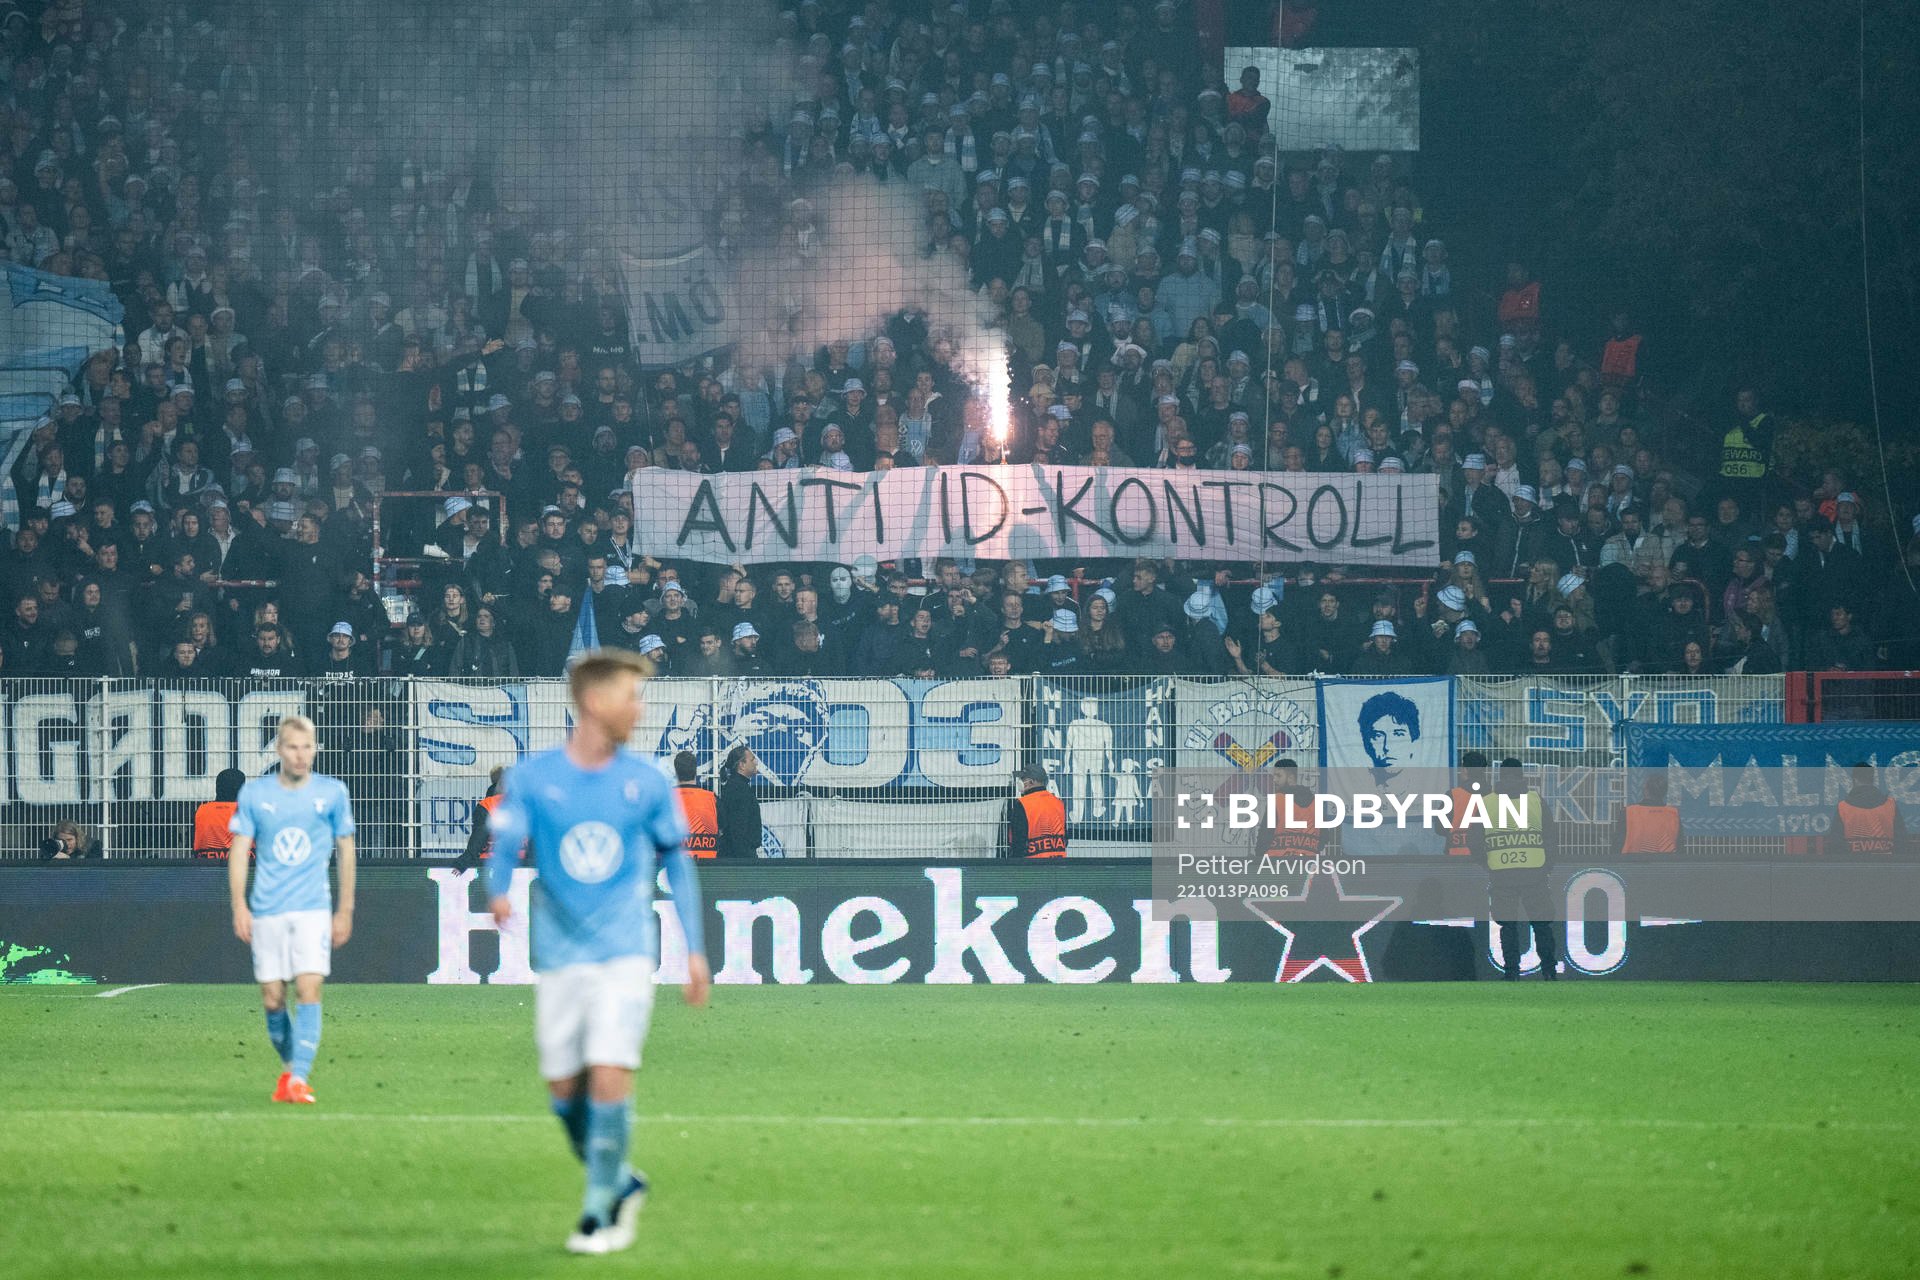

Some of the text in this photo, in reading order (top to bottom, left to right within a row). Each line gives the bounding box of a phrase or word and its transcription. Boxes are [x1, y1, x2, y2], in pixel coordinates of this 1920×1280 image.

[676, 470, 1435, 555] ANTI ID-KONTROLL
[1777, 813, 1832, 834] 1910
[1500, 851, 1528, 865] 023
[427, 867, 1232, 985] Hineken
